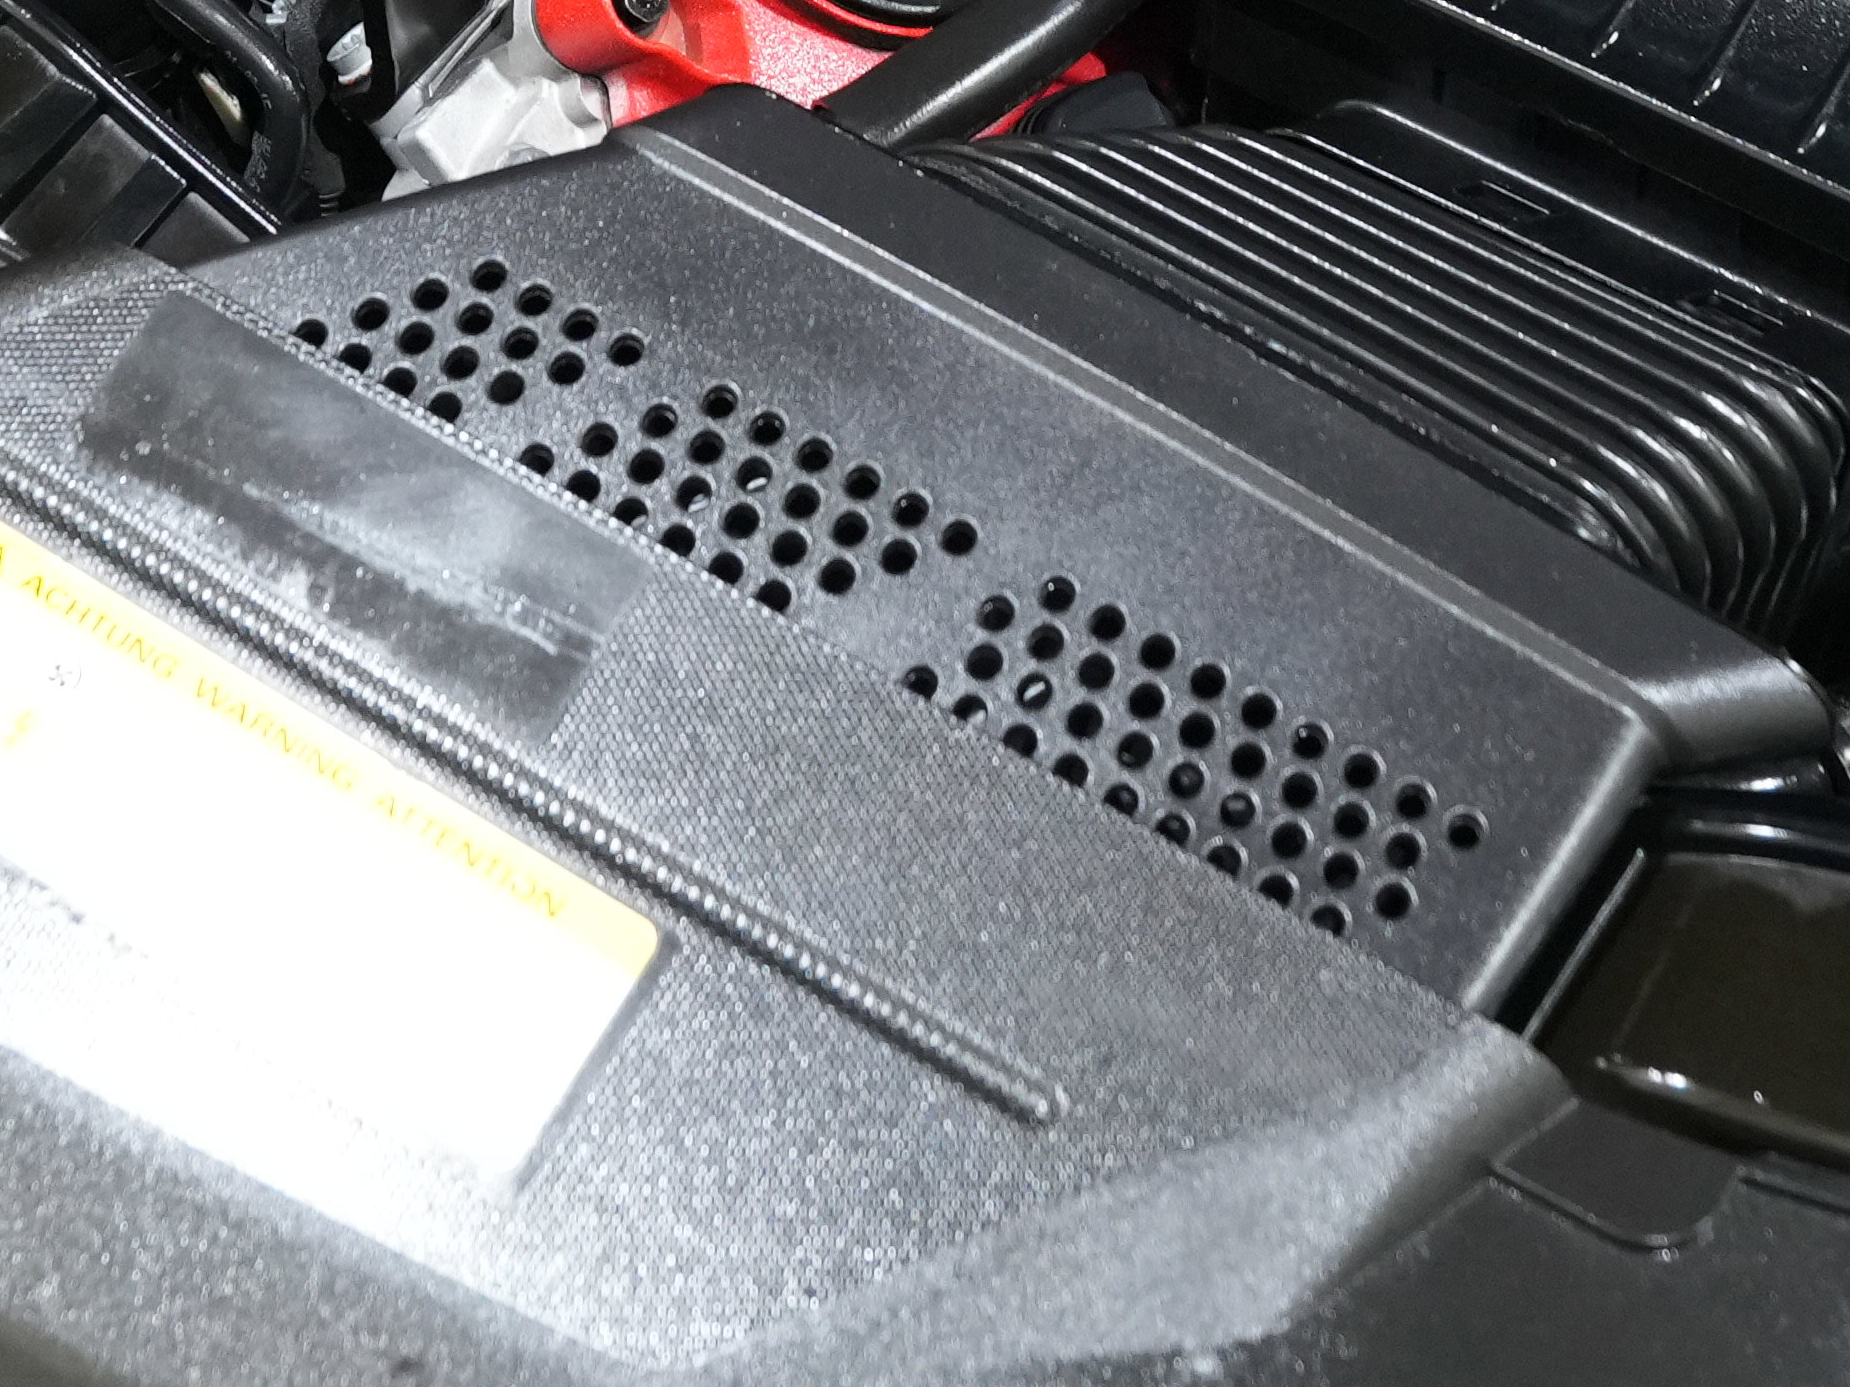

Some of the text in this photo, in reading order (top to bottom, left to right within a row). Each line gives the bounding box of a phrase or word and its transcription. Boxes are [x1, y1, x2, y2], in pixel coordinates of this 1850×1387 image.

[22, 573, 563, 918] ACHTUNG WARNING ATTENTION
